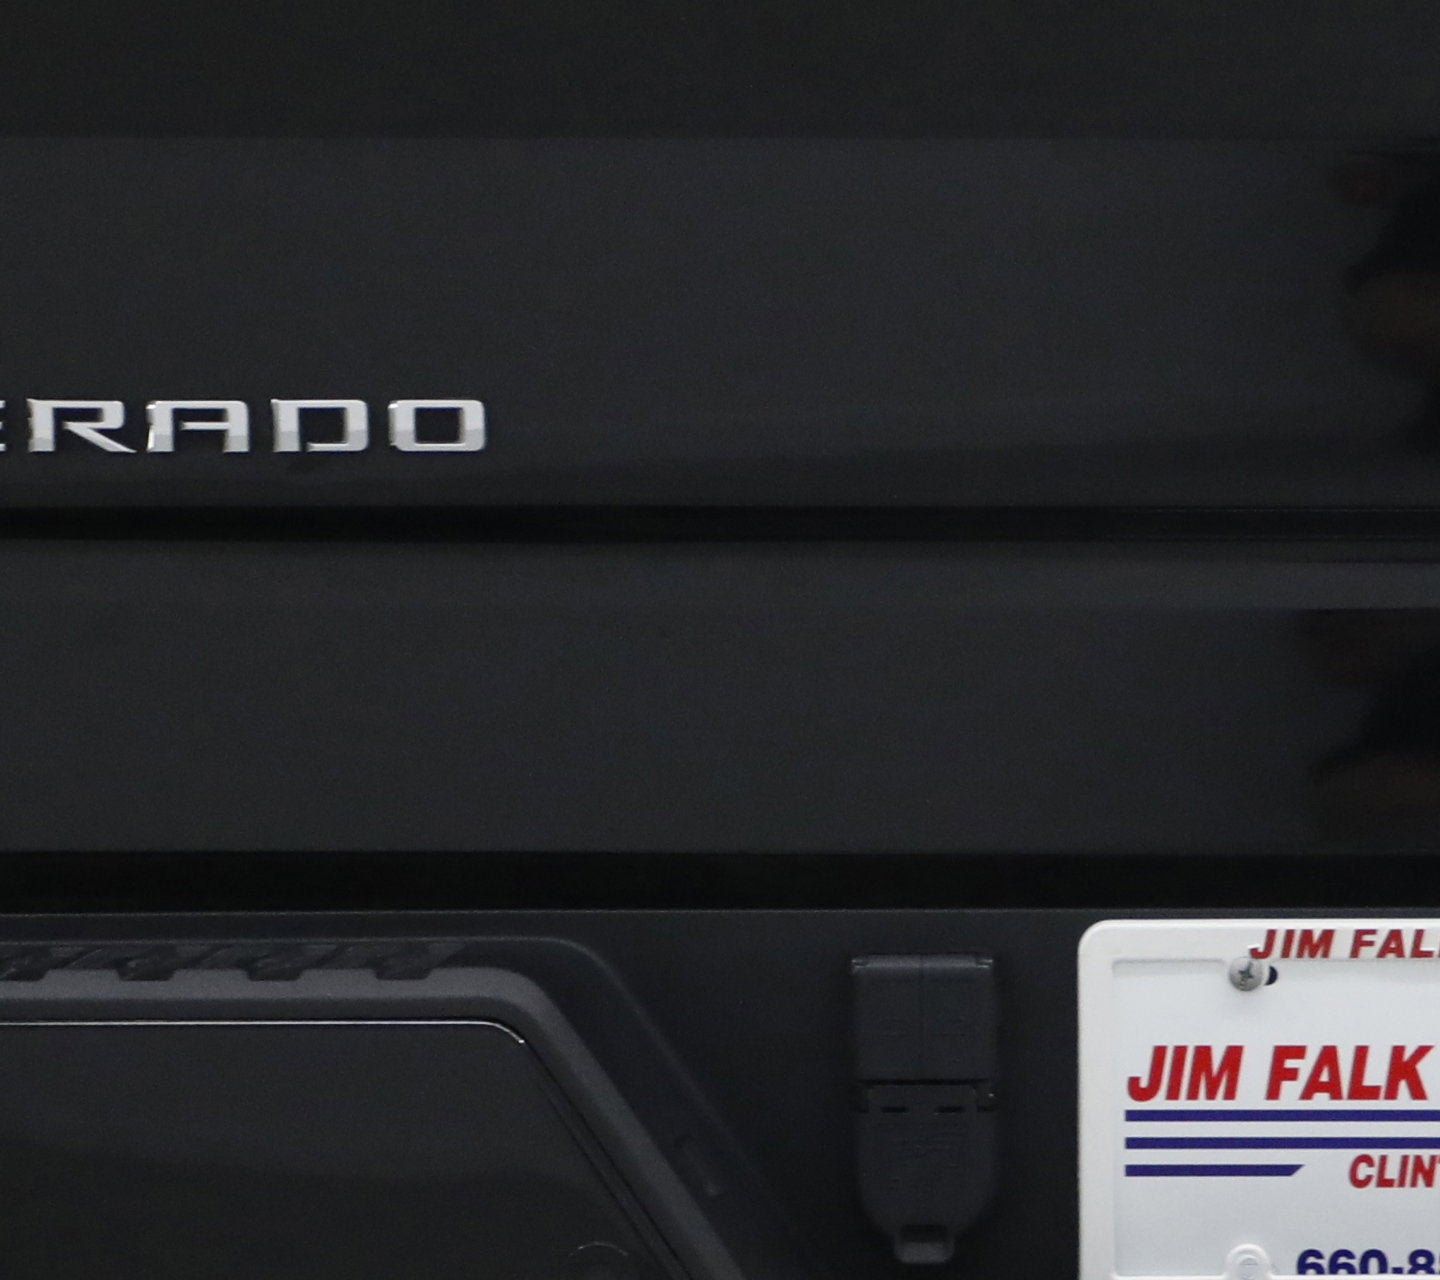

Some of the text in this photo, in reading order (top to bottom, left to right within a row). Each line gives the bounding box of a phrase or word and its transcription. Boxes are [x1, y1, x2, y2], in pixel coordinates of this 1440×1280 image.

[1249, 928, 1332, 960] JIM
[1127, 1044, 1245, 1101] JIM
[1265, 1044, 1434, 1101] FALK
